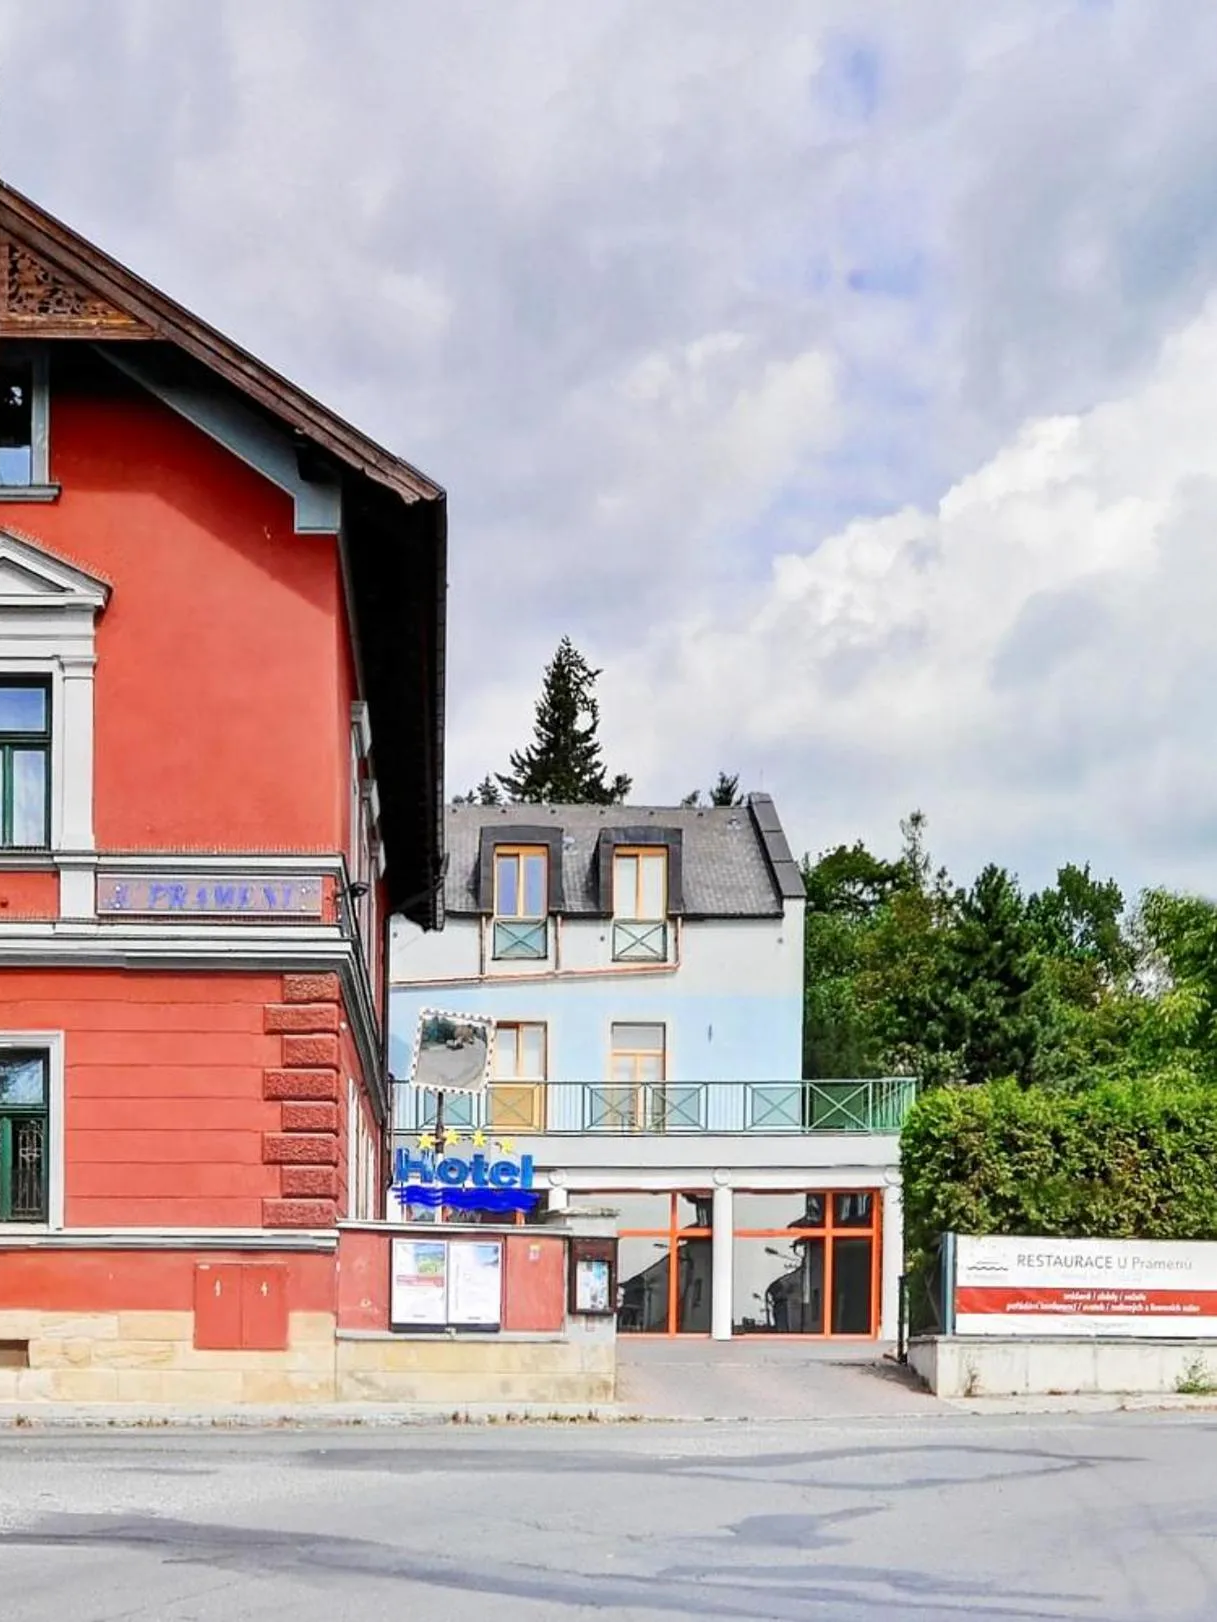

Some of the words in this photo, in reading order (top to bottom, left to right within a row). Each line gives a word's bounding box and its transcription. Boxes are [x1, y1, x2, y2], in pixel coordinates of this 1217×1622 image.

[395, 1148, 533, 1188] Hotel
[1016, 1254, 1113, 1269] RESTAURACE
[1117, 1256, 1127, 1270] U
